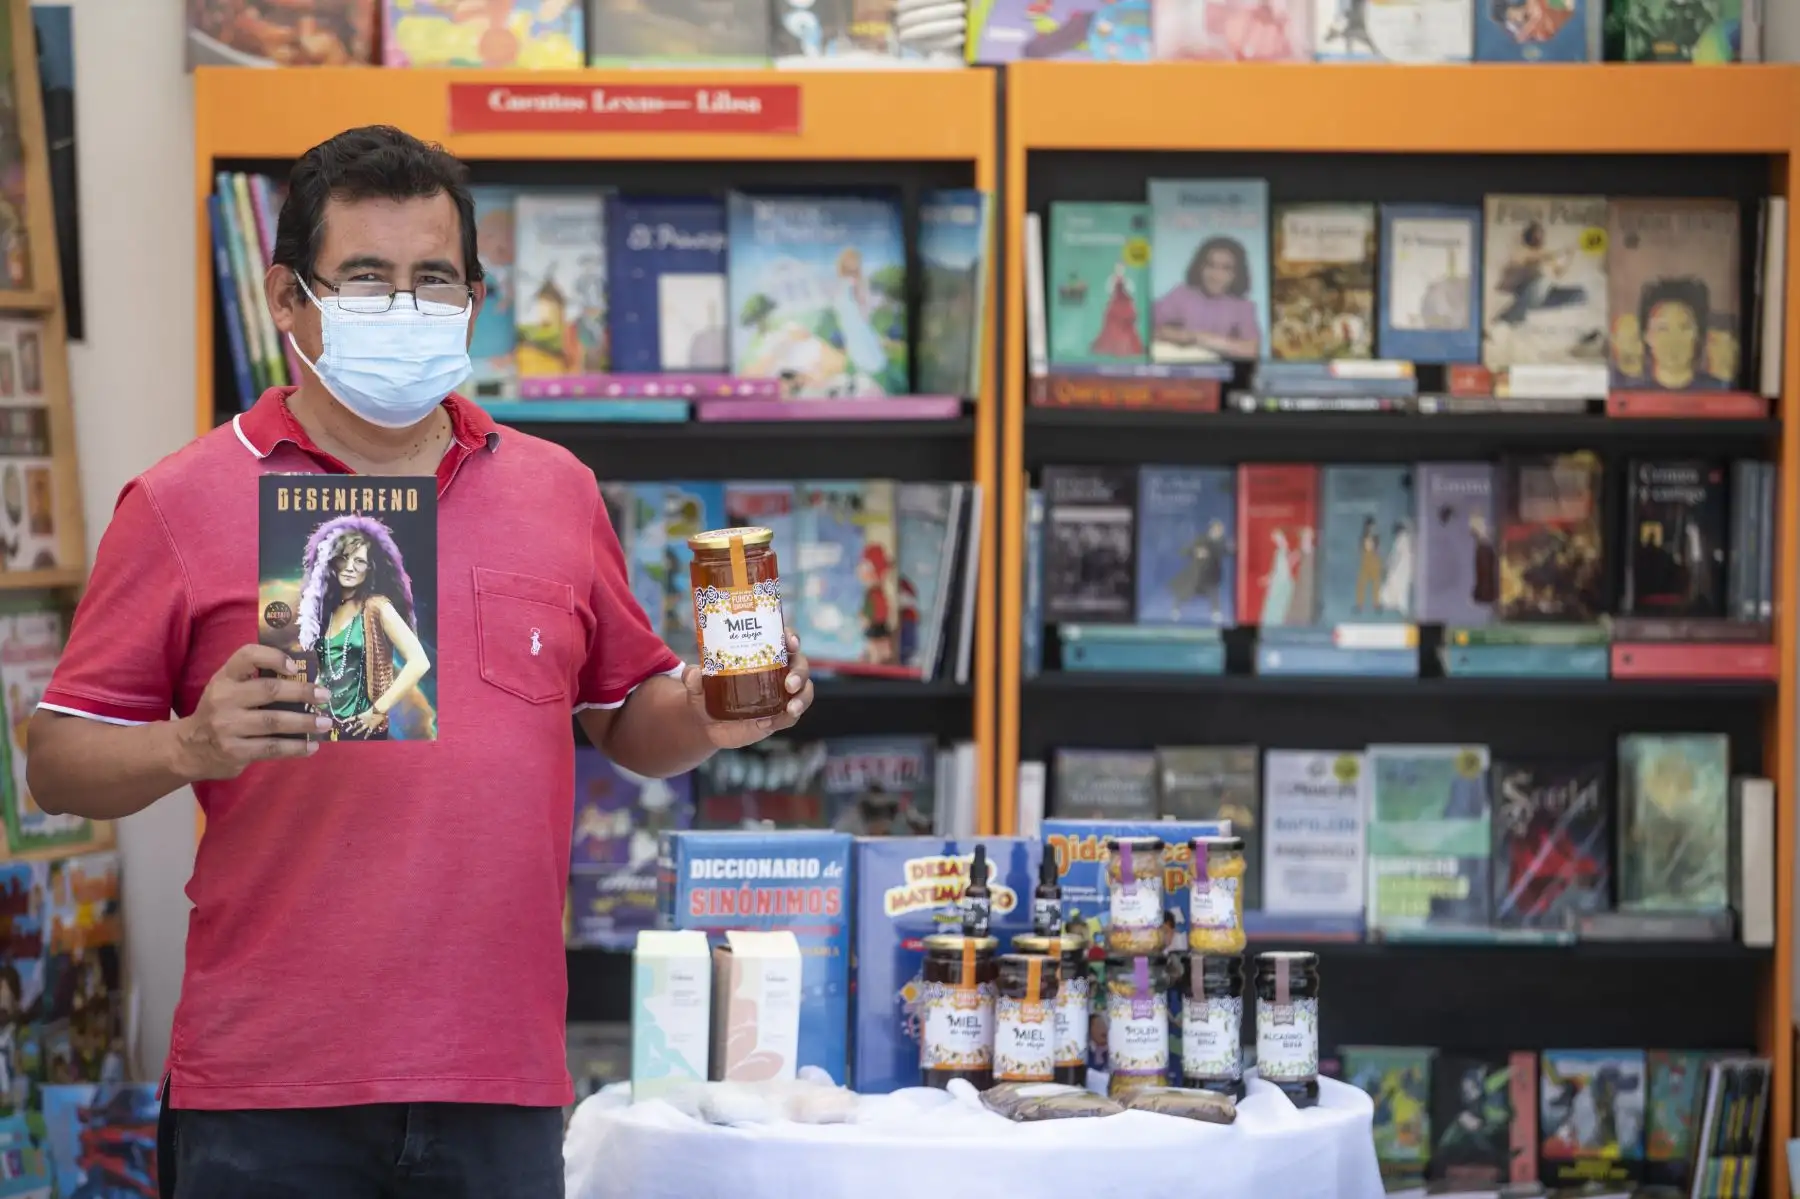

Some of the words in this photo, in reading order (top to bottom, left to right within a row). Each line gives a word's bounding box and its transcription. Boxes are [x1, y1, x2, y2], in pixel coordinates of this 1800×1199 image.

[488, 88, 588, 113] Cuentos
[277, 487, 419, 512] DESENFRENO
[728, 617, 762, 632] MIEL
[741, 632, 762, 640] abeja
[690, 859, 820, 879] DICCIONARIO
[822, 861, 844, 878] de
[690, 882, 841, 916] SINÓNIMOS
[948, 1015, 982, 1028] MIEL
[1014, 1028, 1046, 1041] MIEL
